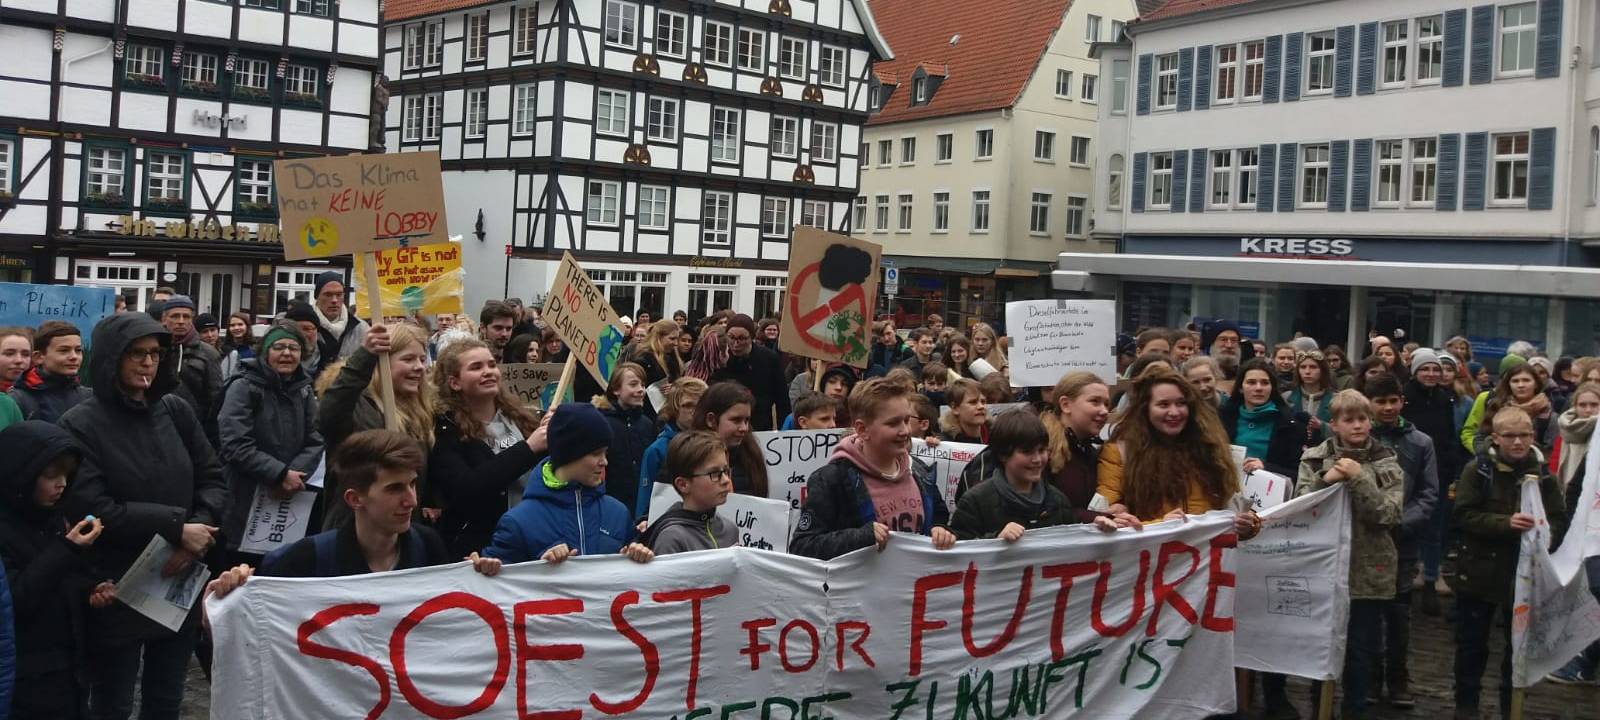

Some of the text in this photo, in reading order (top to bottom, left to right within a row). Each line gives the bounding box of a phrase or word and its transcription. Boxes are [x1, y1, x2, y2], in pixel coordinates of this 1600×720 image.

[192, 109, 248, 130] Hotel
[284, 163, 419, 190] Das Klima
[280, 188, 386, 213] hat KEINE
[257, 223, 282, 243] M
[375, 212, 438, 237] LOBBY
[397, 247, 419, 264] GF
[420, 251, 431, 262] is
[435, 247, 457, 261] not
[1240, 237, 1352, 255] KRESS
[563, 283, 582, 314] NO
[566, 259, 609, 322] THERE IS
[26, 291, 89, 318] Plastik
[546, 295, 597, 366] PLANET B
[522, 368, 549, 382] save
[787, 471, 806, 484] das
[736, 509, 757, 530] Wir
[297, 534, 1237, 720] SOEST FOR FUTURE
